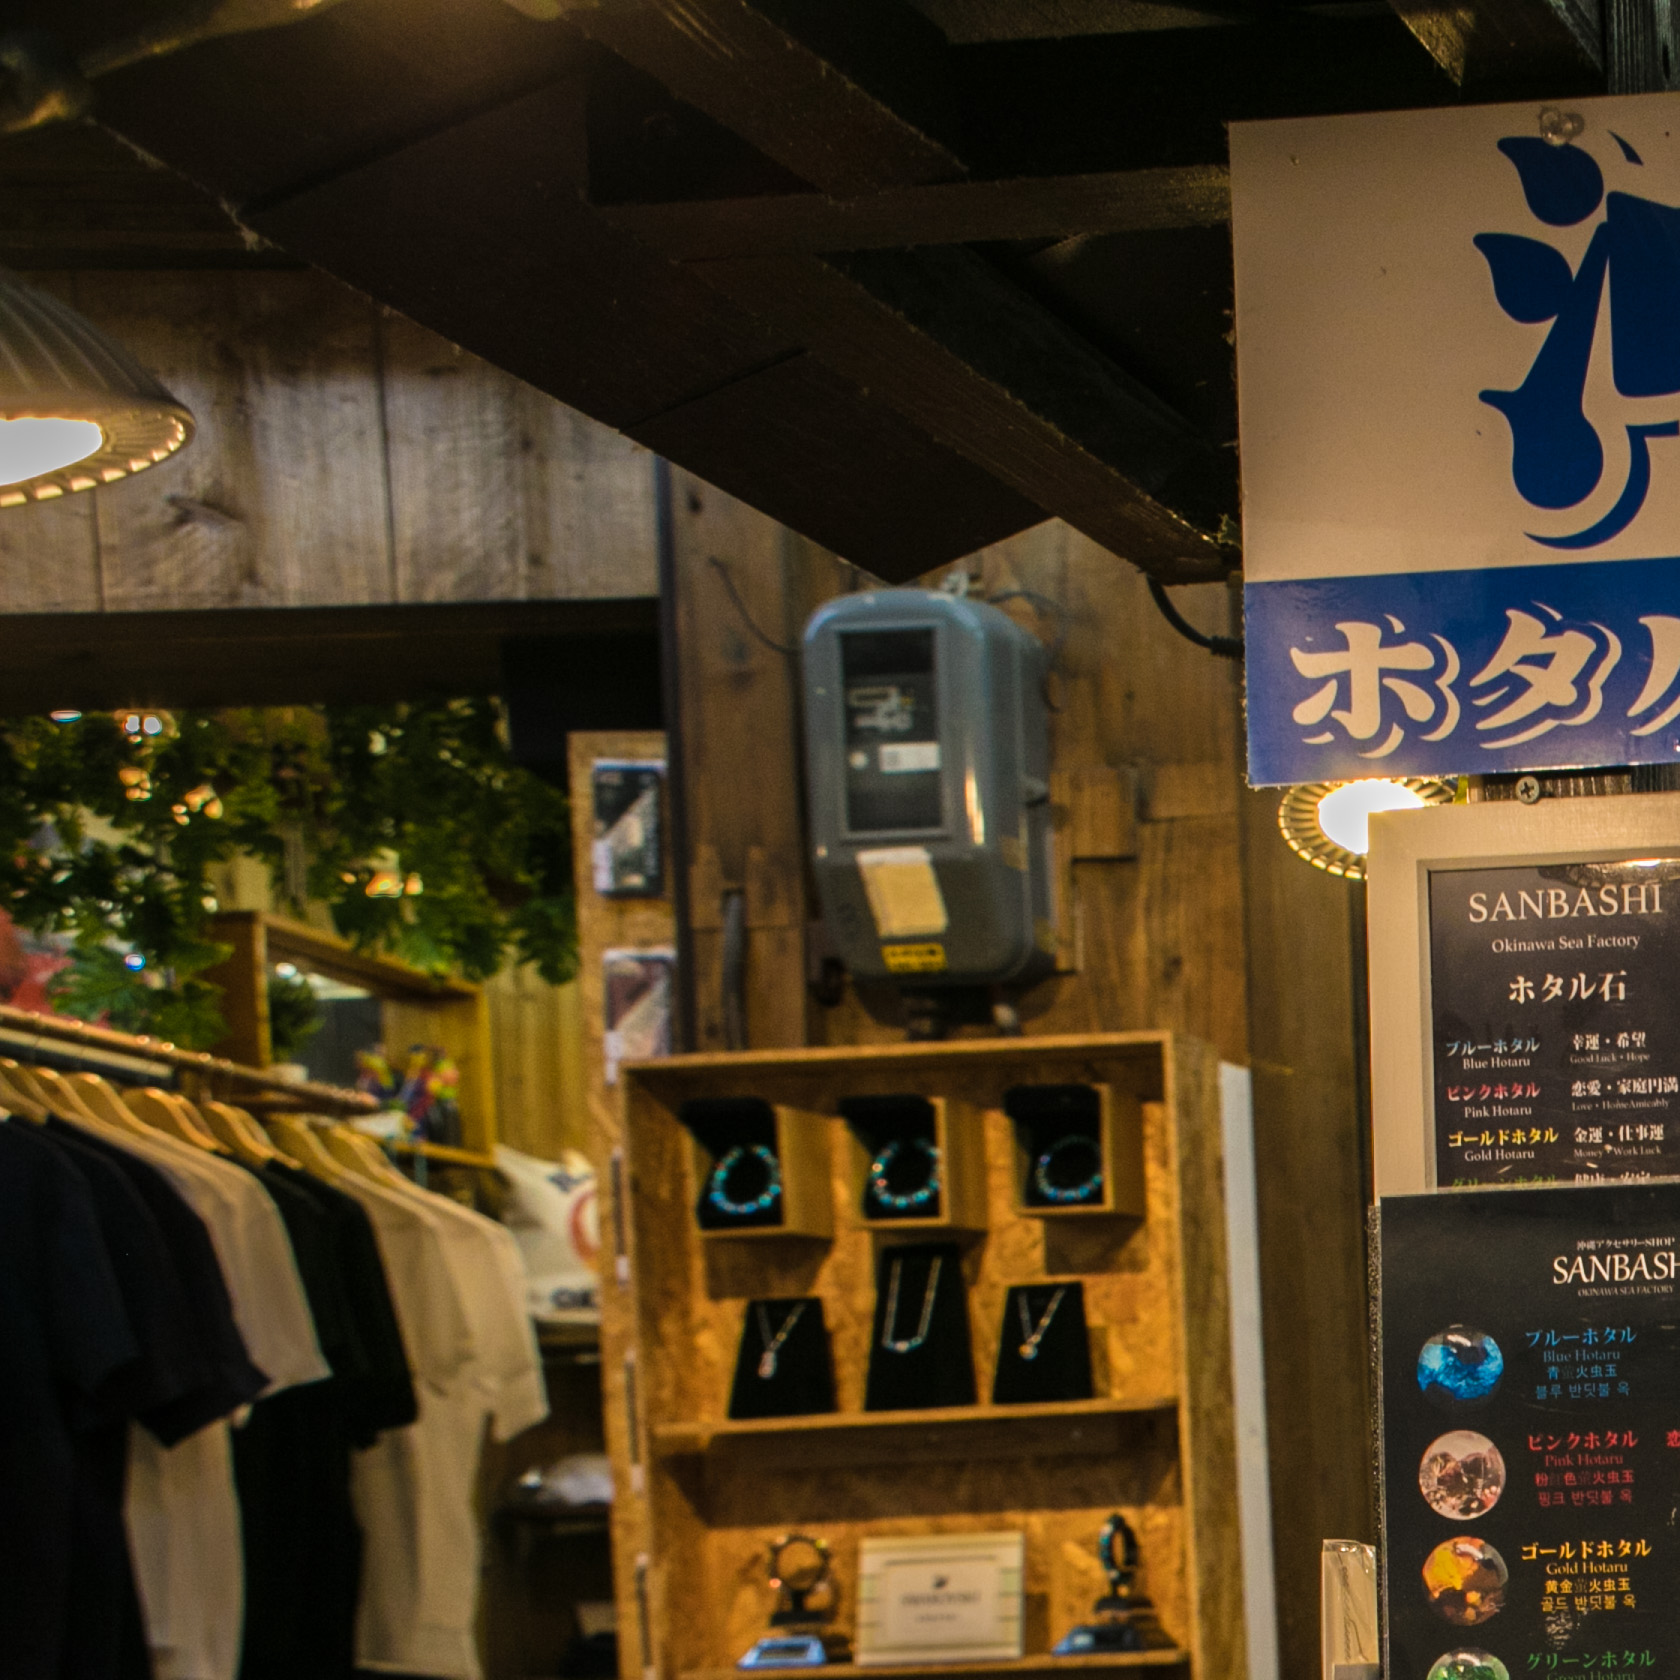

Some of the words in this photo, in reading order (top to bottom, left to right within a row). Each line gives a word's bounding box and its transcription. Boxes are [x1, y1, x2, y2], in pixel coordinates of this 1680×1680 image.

[1469, 884, 1663, 923] SANBASHI
[1492, 937, 1556, 954] Okinawa
[1559, 936, 1583, 950] Sea
[1587, 934, 1640, 952] Factory
[1509, 970, 1627, 1005] ホタル石
[1446, 1038, 1540, 1057] ブルーホタル
[1573, 1032, 1646, 1050] 幸運・希望
[1463, 1058, 1488, 1070] Blue
[1491, 1057, 1530, 1068] Hotaru
[1447, 1083, 1541, 1101] ピンクホタル
[1572, 1077, 1678, 1097] 恋愛・家庭円満
[1464, 1106, 1490, 1118] Pink
[1493, 1105, 1532, 1116] Hotaru
[1448, 1128, 1558, 1147] ゴールドホタル
[1574, 1124, 1664, 1143] 金運・仕事運
[1465, 1150, 1492, 1162] Gold
[1495, 1150, 1534, 1161] Hotaru
[1578, 1287, 1618, 1297] OKINAWA
[1620, 1286, 1634, 1295] SEA
[1636, 1285, 1674, 1295] FACTORY
[1525, 1326, 1637, 1347] ブルーホタル
[1528, 1431, 1638, 1451] ピンクホタル
[1521, 1539, 1651, 1561] ゴールドホタル
[1546, 1562, 1578, 1575] Gold
[1582, 1561, 1628, 1574] Hotaru
[1527, 1650, 1655, 1670] グリーンホタル
